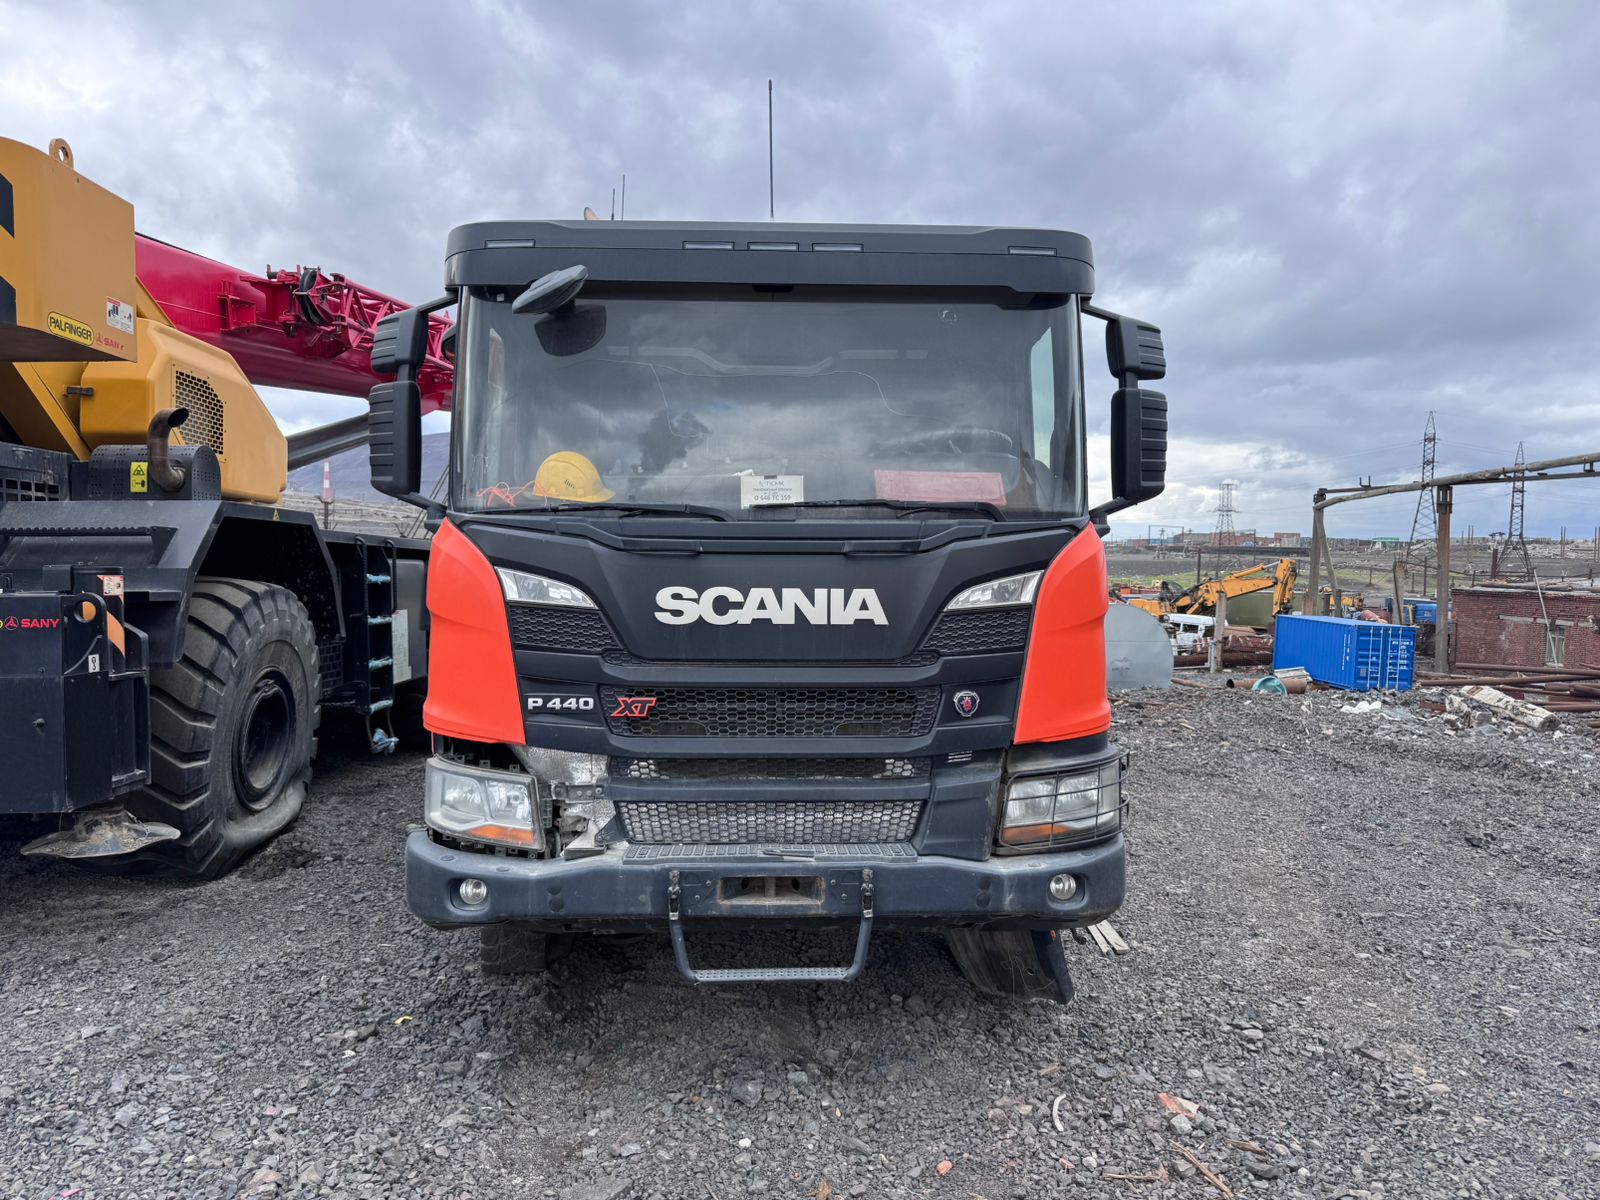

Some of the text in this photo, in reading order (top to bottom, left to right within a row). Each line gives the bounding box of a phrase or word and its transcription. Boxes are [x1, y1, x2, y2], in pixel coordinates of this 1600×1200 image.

[49, 316, 92, 341] PALFINGER
[654, 586, 889, 626] SCANIA
[21, 619, 60, 628] SANY
[527, 697, 594, 710] P 440
[611, 697, 657, 717] XT
